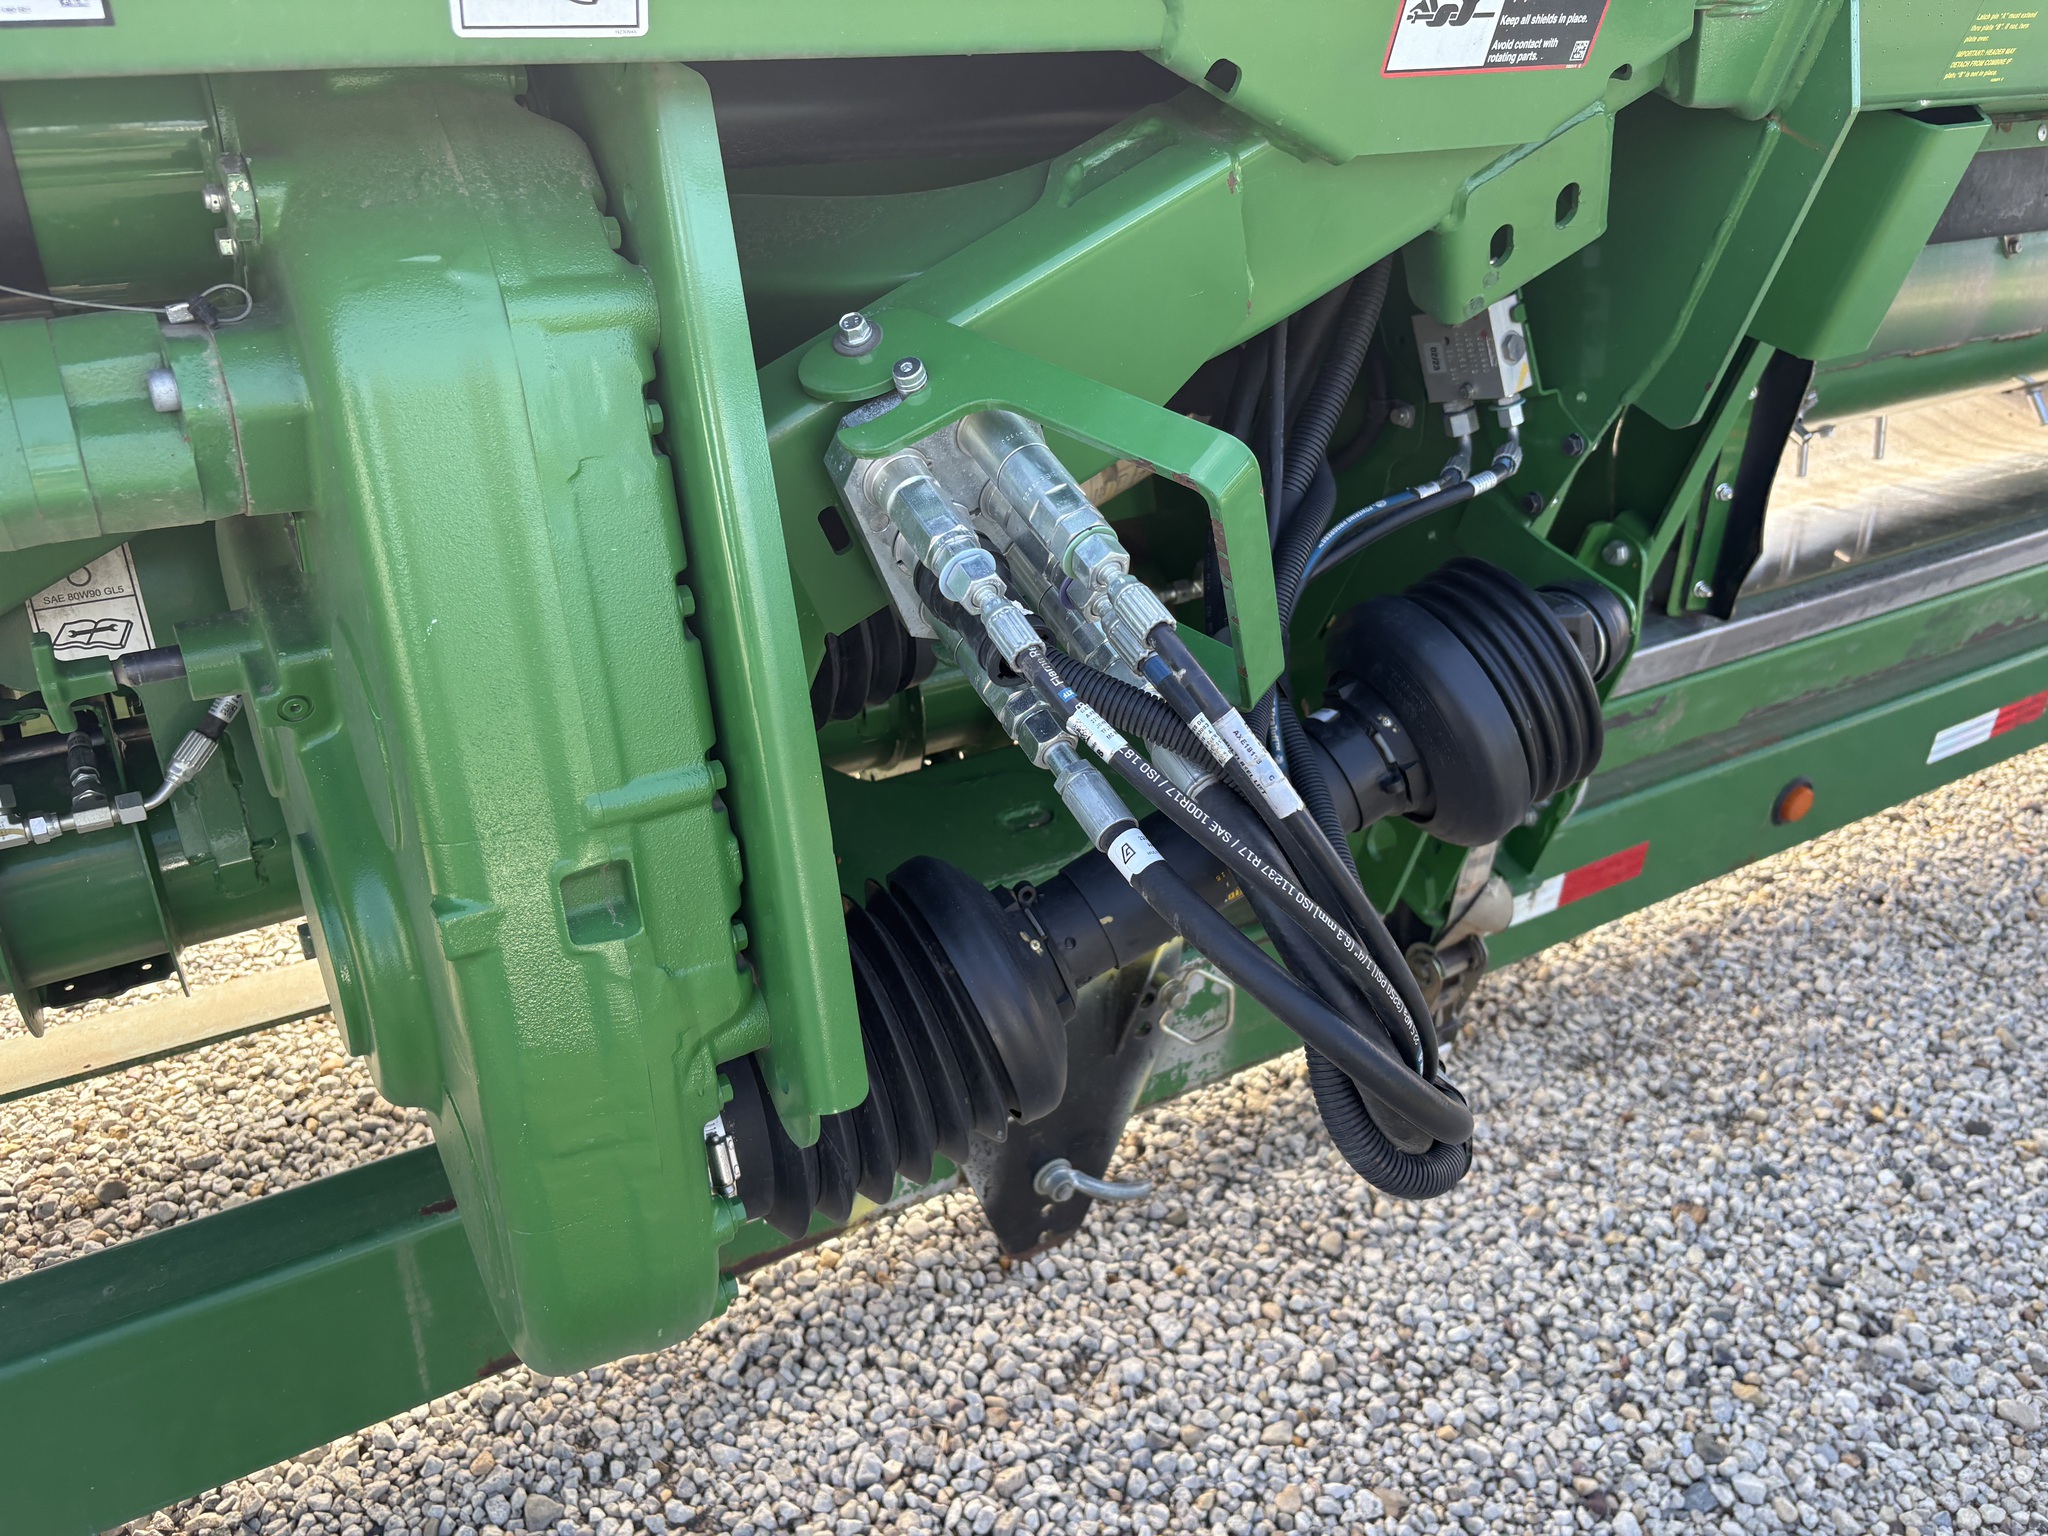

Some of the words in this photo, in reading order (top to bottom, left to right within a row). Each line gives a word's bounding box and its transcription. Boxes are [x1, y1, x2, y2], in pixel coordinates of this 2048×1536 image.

[1500, 14, 1519, 27] Keep
[1520, 14, 1530, 24] all
[1531, 13, 1558, 24] shields
[1558, 13, 1566, 23] in
[1566, 13, 1588, 26] place.
[1980, 24, 1994, 32] plate
[1491, 39, 1514, 50] Avoid
[1514, 38, 1542, 49] contact
[1542, 38, 1558, 48] with
[1963, 36, 1977, 44] plate
[1487, 52, 1516, 63] rotating
[1516, 51, 1538, 64] parts.
[1943, 72, 1956, 80] plate
[43, 594, 65, 605] SAE
[68, 588, 101, 600] 80W90
[104, 586, 124, 596] GL5
[1140, 762, 1161, 782] ISO
[1165, 787, 1210, 825] 100R17
[1208, 821, 1232, 843] SAE
[1238, 846, 1262, 868] R17
[1261, 865, 1296, 896] 11237
[1295, 892, 1314, 912] ISO
